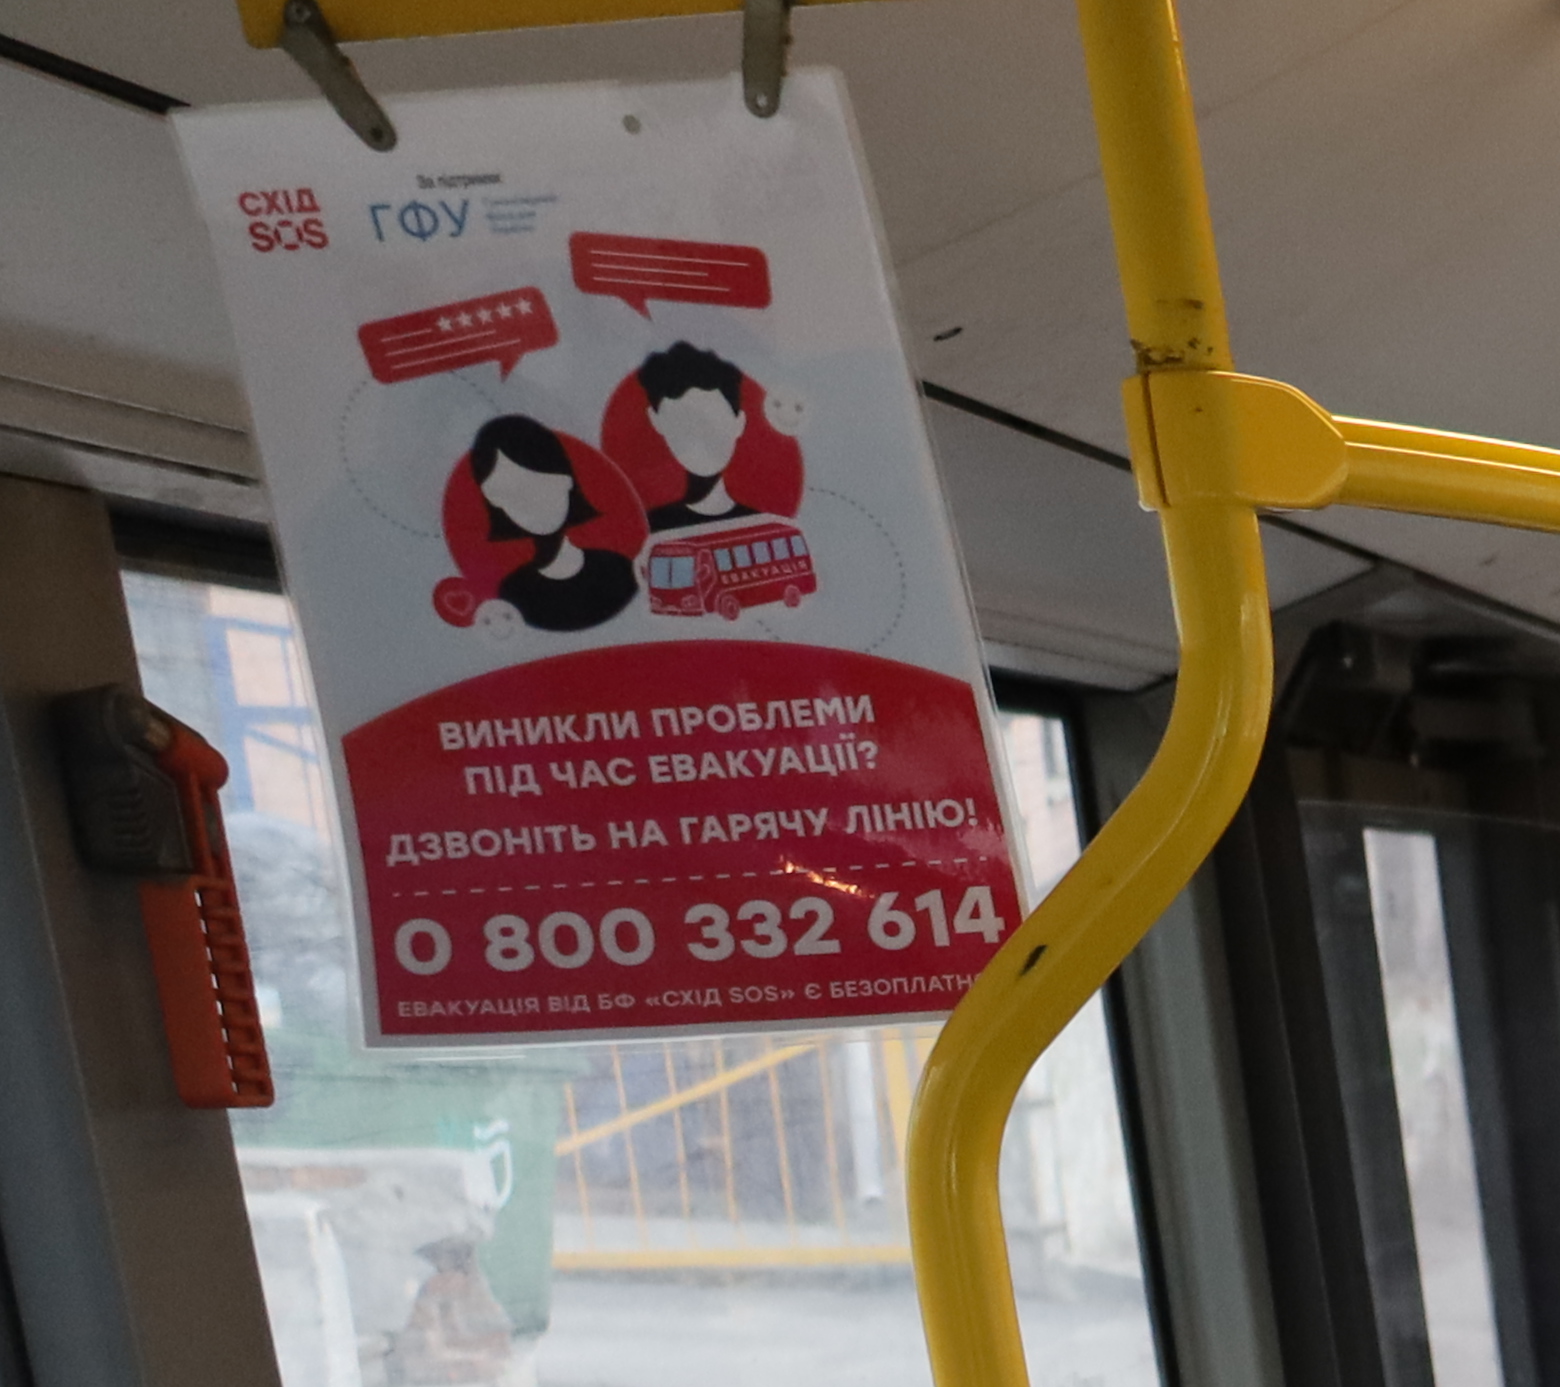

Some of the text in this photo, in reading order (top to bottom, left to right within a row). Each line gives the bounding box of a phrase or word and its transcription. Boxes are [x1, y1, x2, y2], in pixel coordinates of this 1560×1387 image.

[237, 187, 321, 216] СХІД
[368, 199, 470, 242] ГФУ
[248, 218, 329, 252] SOS
[720, 561, 808, 585] ЕВАКУАЦІЯ
[438, 695, 876, 752] ВИНИКЛИ ПРОБЛЕМИ
[464, 733, 880, 798] ПІД ЧАС ЕВАКУАЦІЇ?
[386, 798, 979, 867] ДЗВОНІТЬ НА ГАРЯЧУ ЛІНІЮ!
[393, 886, 1006, 976] 0 800 332 614
[398, 997, 540, 1017] ЕВАКУАЦІЯ
[548, 994, 592, 1013] ВІД
[598, 992, 636, 1010] БФ
[804, 983, 822, 999] Є
